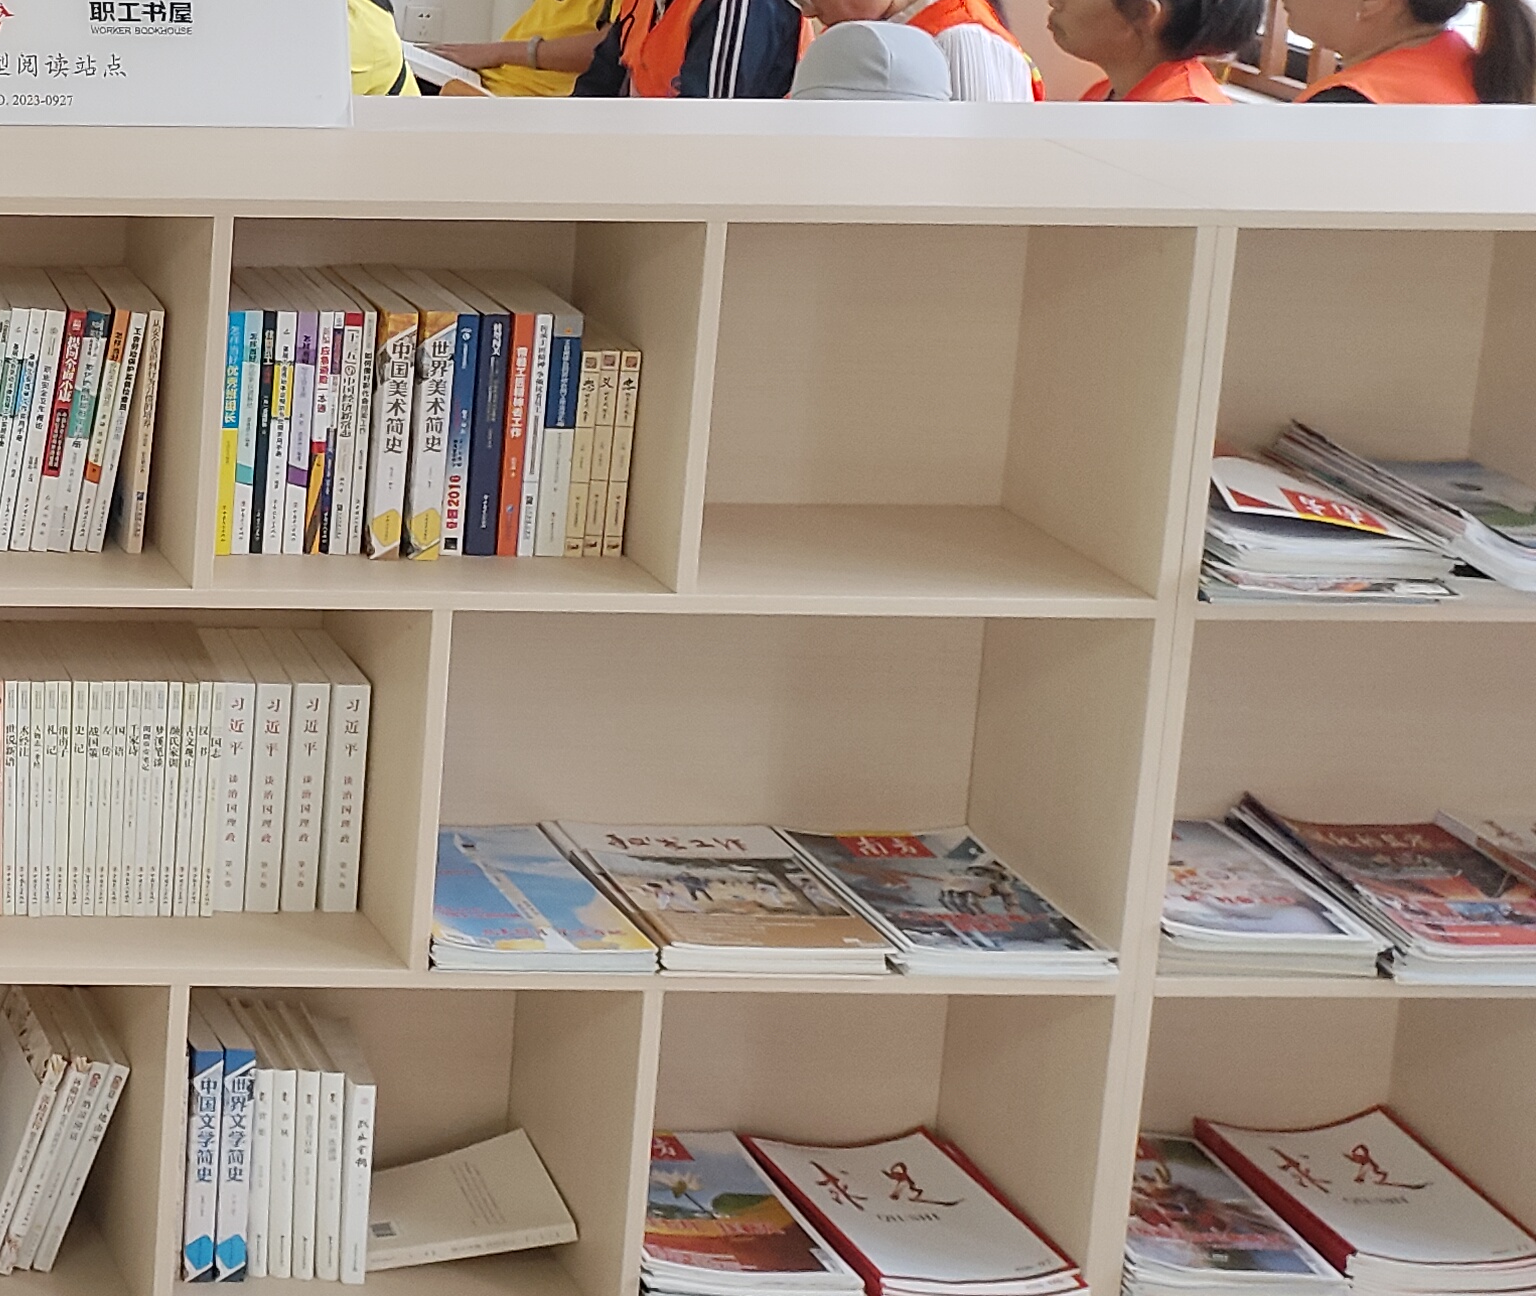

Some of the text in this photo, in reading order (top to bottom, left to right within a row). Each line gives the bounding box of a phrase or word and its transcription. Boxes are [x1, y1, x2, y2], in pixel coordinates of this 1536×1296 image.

[89, 1, 194, 25] 职工书屋
[12, 93, 74, 108] 2023-0927
[384, 341, 412, 455] 中国美术简史
[423, 340, 451, 453] 世界美术简史
[225, 697, 246, 844] 习近平 谈治国理政
[261, 697, 281, 844] 习近平 谈治国理政
[298, 697, 320, 844] 习近平 谈治国理政
[339, 697, 361, 844] 习近平 谈治国理政
[195, 1077, 219, 1184] 中国文学简史
[226, 1075, 249, 1184] 世界文学简史
